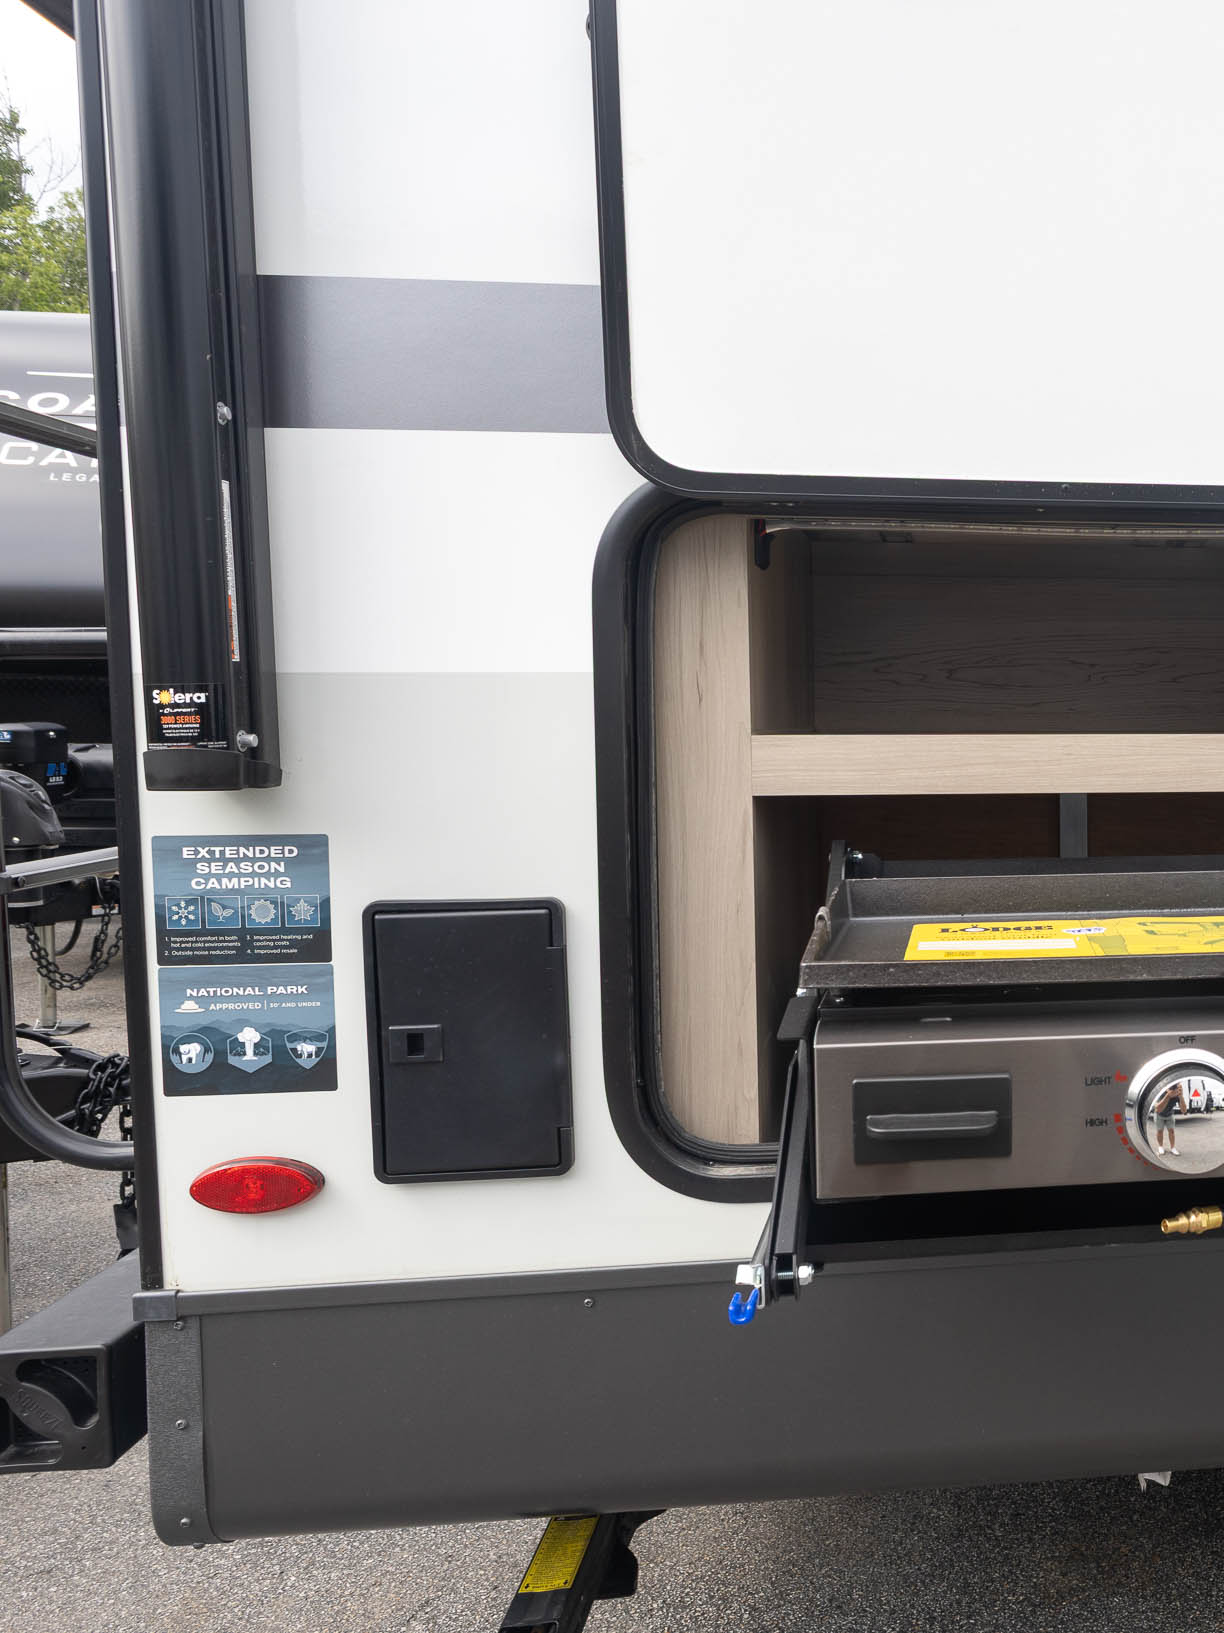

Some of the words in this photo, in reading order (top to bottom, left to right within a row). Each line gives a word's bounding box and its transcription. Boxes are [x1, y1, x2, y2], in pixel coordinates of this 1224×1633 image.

[0, 442, 98, 467] CA
[152, 688, 207, 704] Solera
[176, 715, 200, 723] SERIES
[182, 846, 298, 859] EXTENDED
[195, 861, 285, 874] SEASON
[190, 877, 292, 890] CAMPING
[186, 987, 264, 997] NATIONAL
[267, 985, 308, 994] PARK
[209, 1002, 262, 1011] APPROVED
[1179, 1036, 1196, 1044] OFF
[1085, 1077, 1112, 1086] LIGHT
[1085, 1118, 1108, 1127] HIGH
